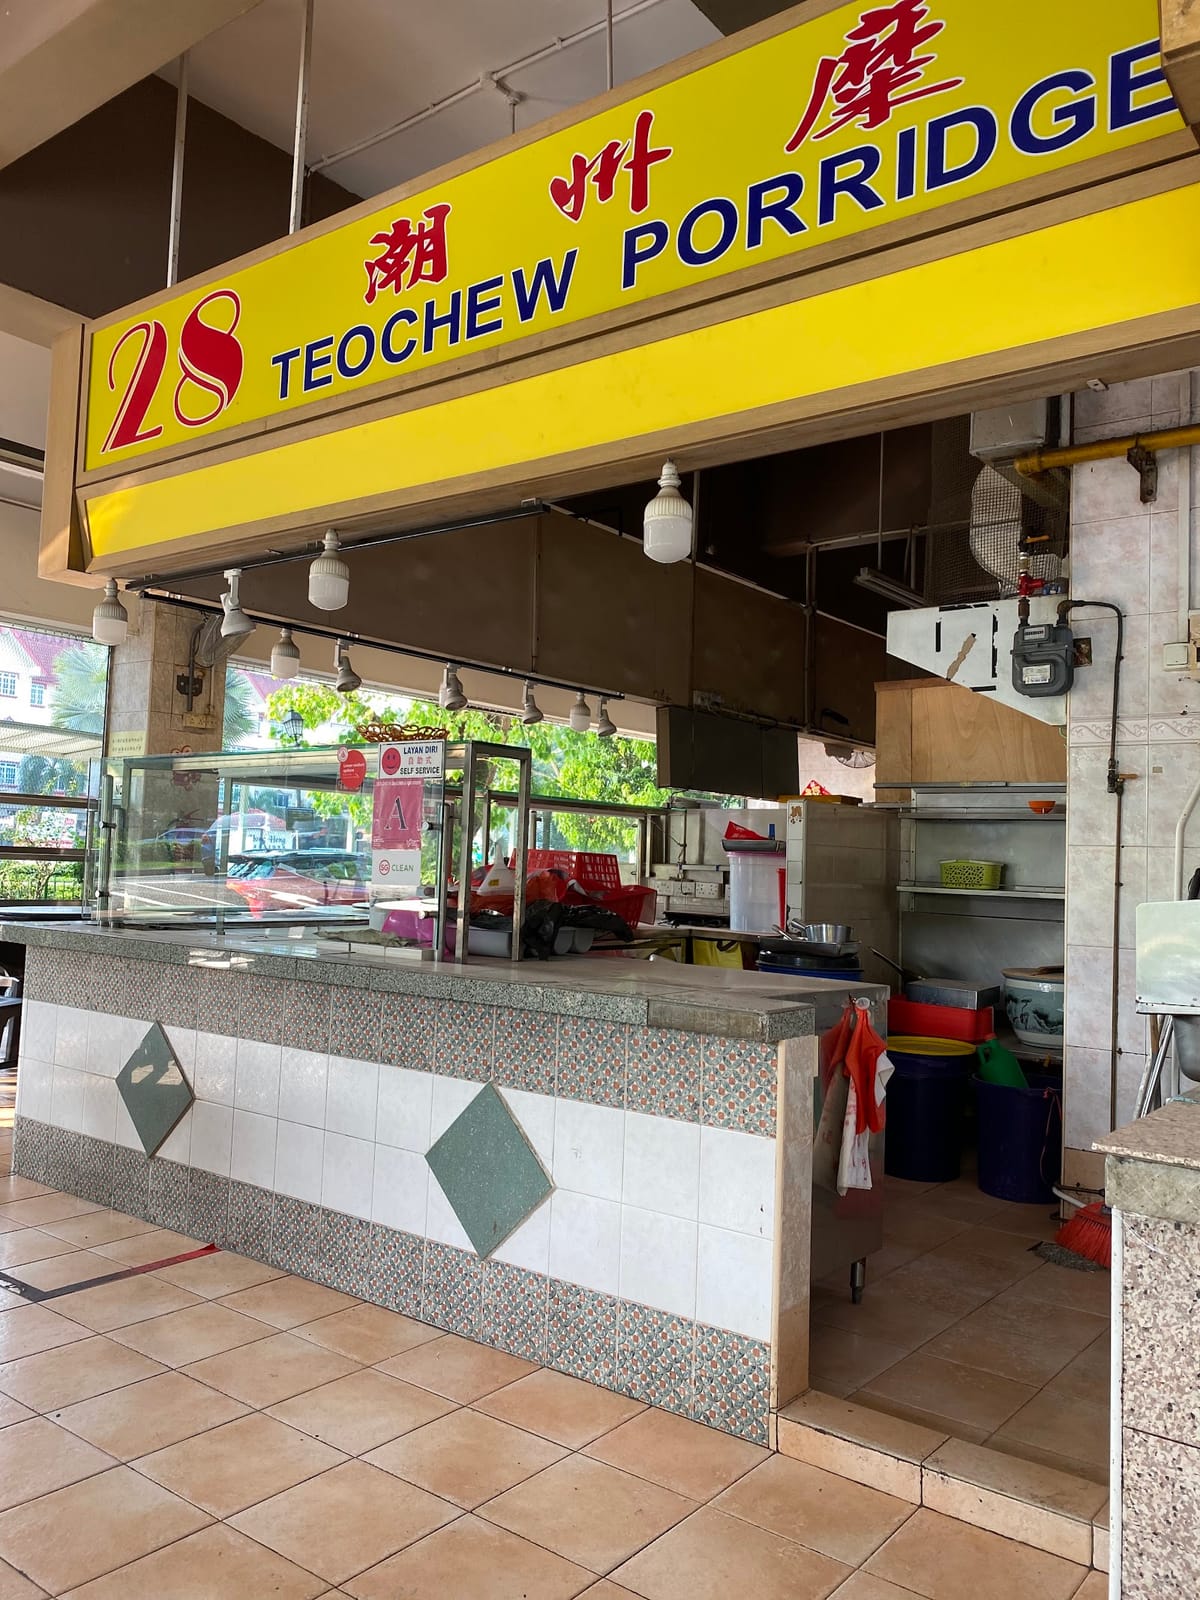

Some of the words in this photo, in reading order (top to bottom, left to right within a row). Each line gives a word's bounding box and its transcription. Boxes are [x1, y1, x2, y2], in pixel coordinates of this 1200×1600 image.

[272, 248, 578, 400] TEOCHEW
[621, 37, 1179, 291] PORRIDGE
[101, 289, 244, 455] 28
[403, 746, 423, 755] LAYAN
[425, 745, 438, 753] DIRI
[408, 756, 432, 765] 自助式
[400, 767, 414, 775] SELF
[415, 766, 440, 775] SERVICE
[384, 796, 409, 831] A
[391, 864, 414, 872] CLEAN
